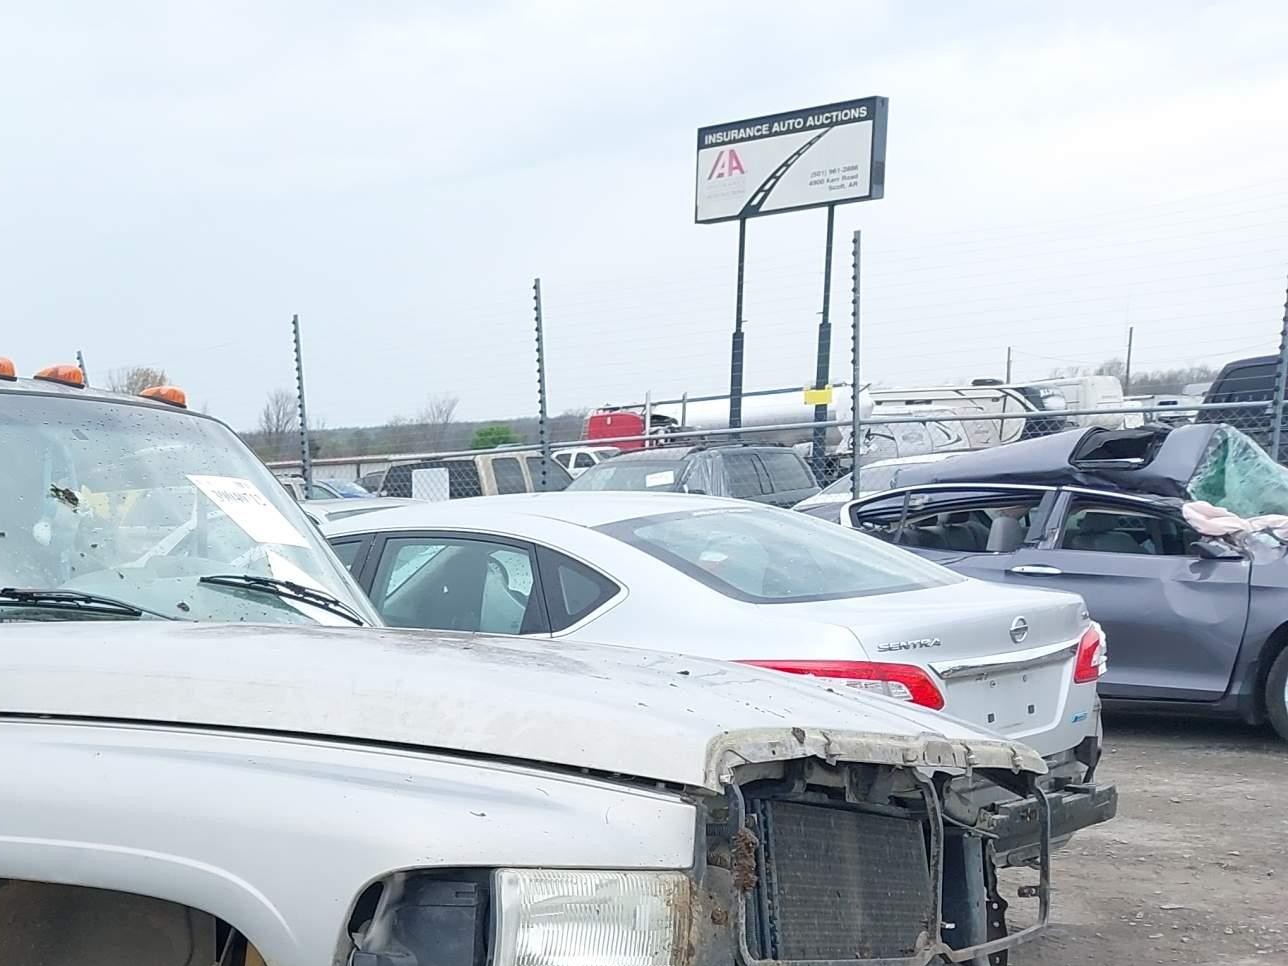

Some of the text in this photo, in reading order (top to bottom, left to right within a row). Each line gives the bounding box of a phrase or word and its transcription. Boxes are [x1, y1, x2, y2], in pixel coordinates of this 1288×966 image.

[704, 106, 868, 145] INSURANCE AUTO AUCTIONS
[877, 637, 941, 652] SENTRA
